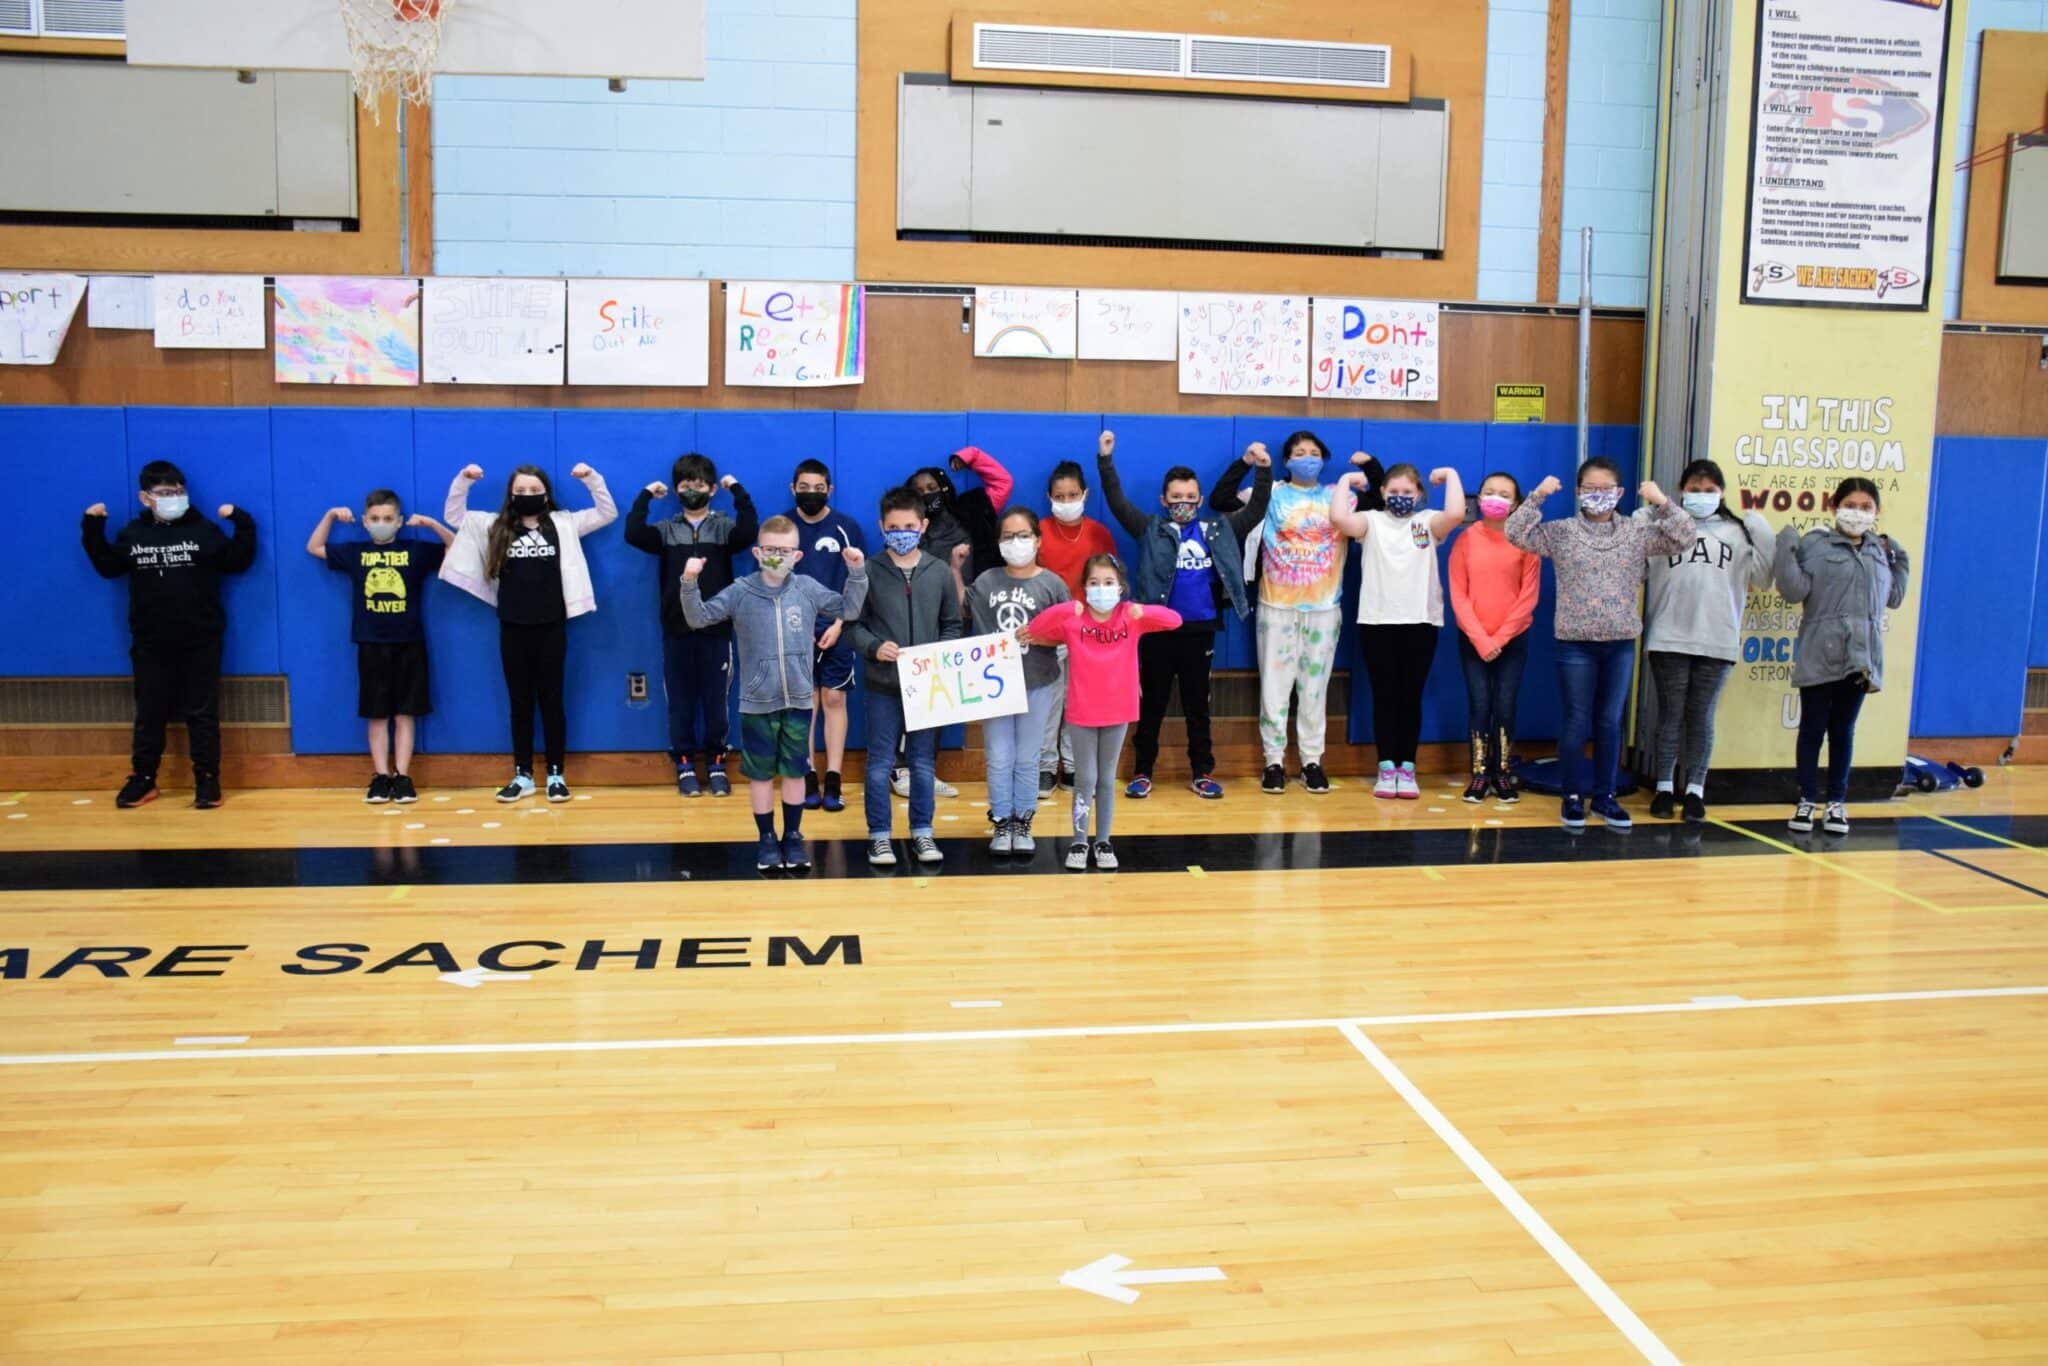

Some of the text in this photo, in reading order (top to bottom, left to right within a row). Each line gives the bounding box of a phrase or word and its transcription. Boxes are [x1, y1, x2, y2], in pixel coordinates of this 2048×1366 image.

[1772, 31, 1797, 40] Respect
[1771, 41, 1797, 50] Respect
[1798, 43, 1808, 51] the
[1779, 51, 1789, 60] the
[1771, 60, 1795, 70] Support
[1807, 63, 1833, 73] children
[1770, 103, 1792, 113] WILL
[1796, 264, 1815, 289] WE
[1814, 265, 1836, 289] ARE
[1342, 305, 1427, 347] Dont
[1313, 357, 1420, 397] give up
[1500, 387, 1541, 396] WARNING
[1762, 395, 1894, 434] IN THIS
[1734, 434, 1906, 473] CLASSROOM
[1737, 473, 1761, 489] WE
[1769, 475, 1797, 490] ARE
[1801, 476, 1817, 490] AS
[1889, 478, 1900, 492] A
[1739, 488, 1840, 514] WOOK
[130, 540, 200, 556] Abercrombie
[506, 546, 556, 558] adidas
[137, 553, 158, 564] and
[360, 550, 409, 566] TOP-TIER
[366, 599, 406, 613] PLAYER
[1011, 587, 1036, 610] the
[970, 639, 1009, 662] out
[1748, 666, 1795, 681] STRON
[927, 663, 1005, 711] ALS
[281, 934, 864, 977] SACHEM
